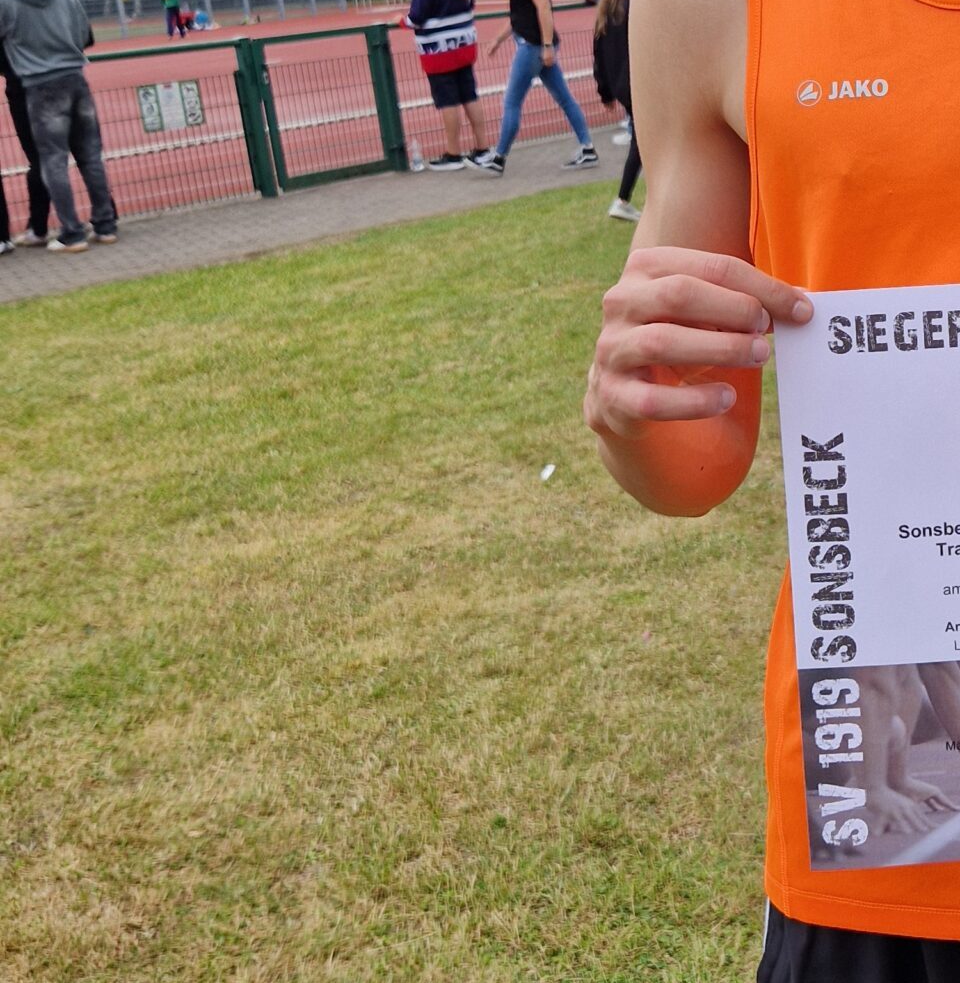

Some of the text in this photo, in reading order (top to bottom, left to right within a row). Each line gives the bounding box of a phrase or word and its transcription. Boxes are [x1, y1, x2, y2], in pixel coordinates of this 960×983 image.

[828, 78, 889, 100] JAKO
[801, 432, 869, 846] SV 1919 SONSBECK
